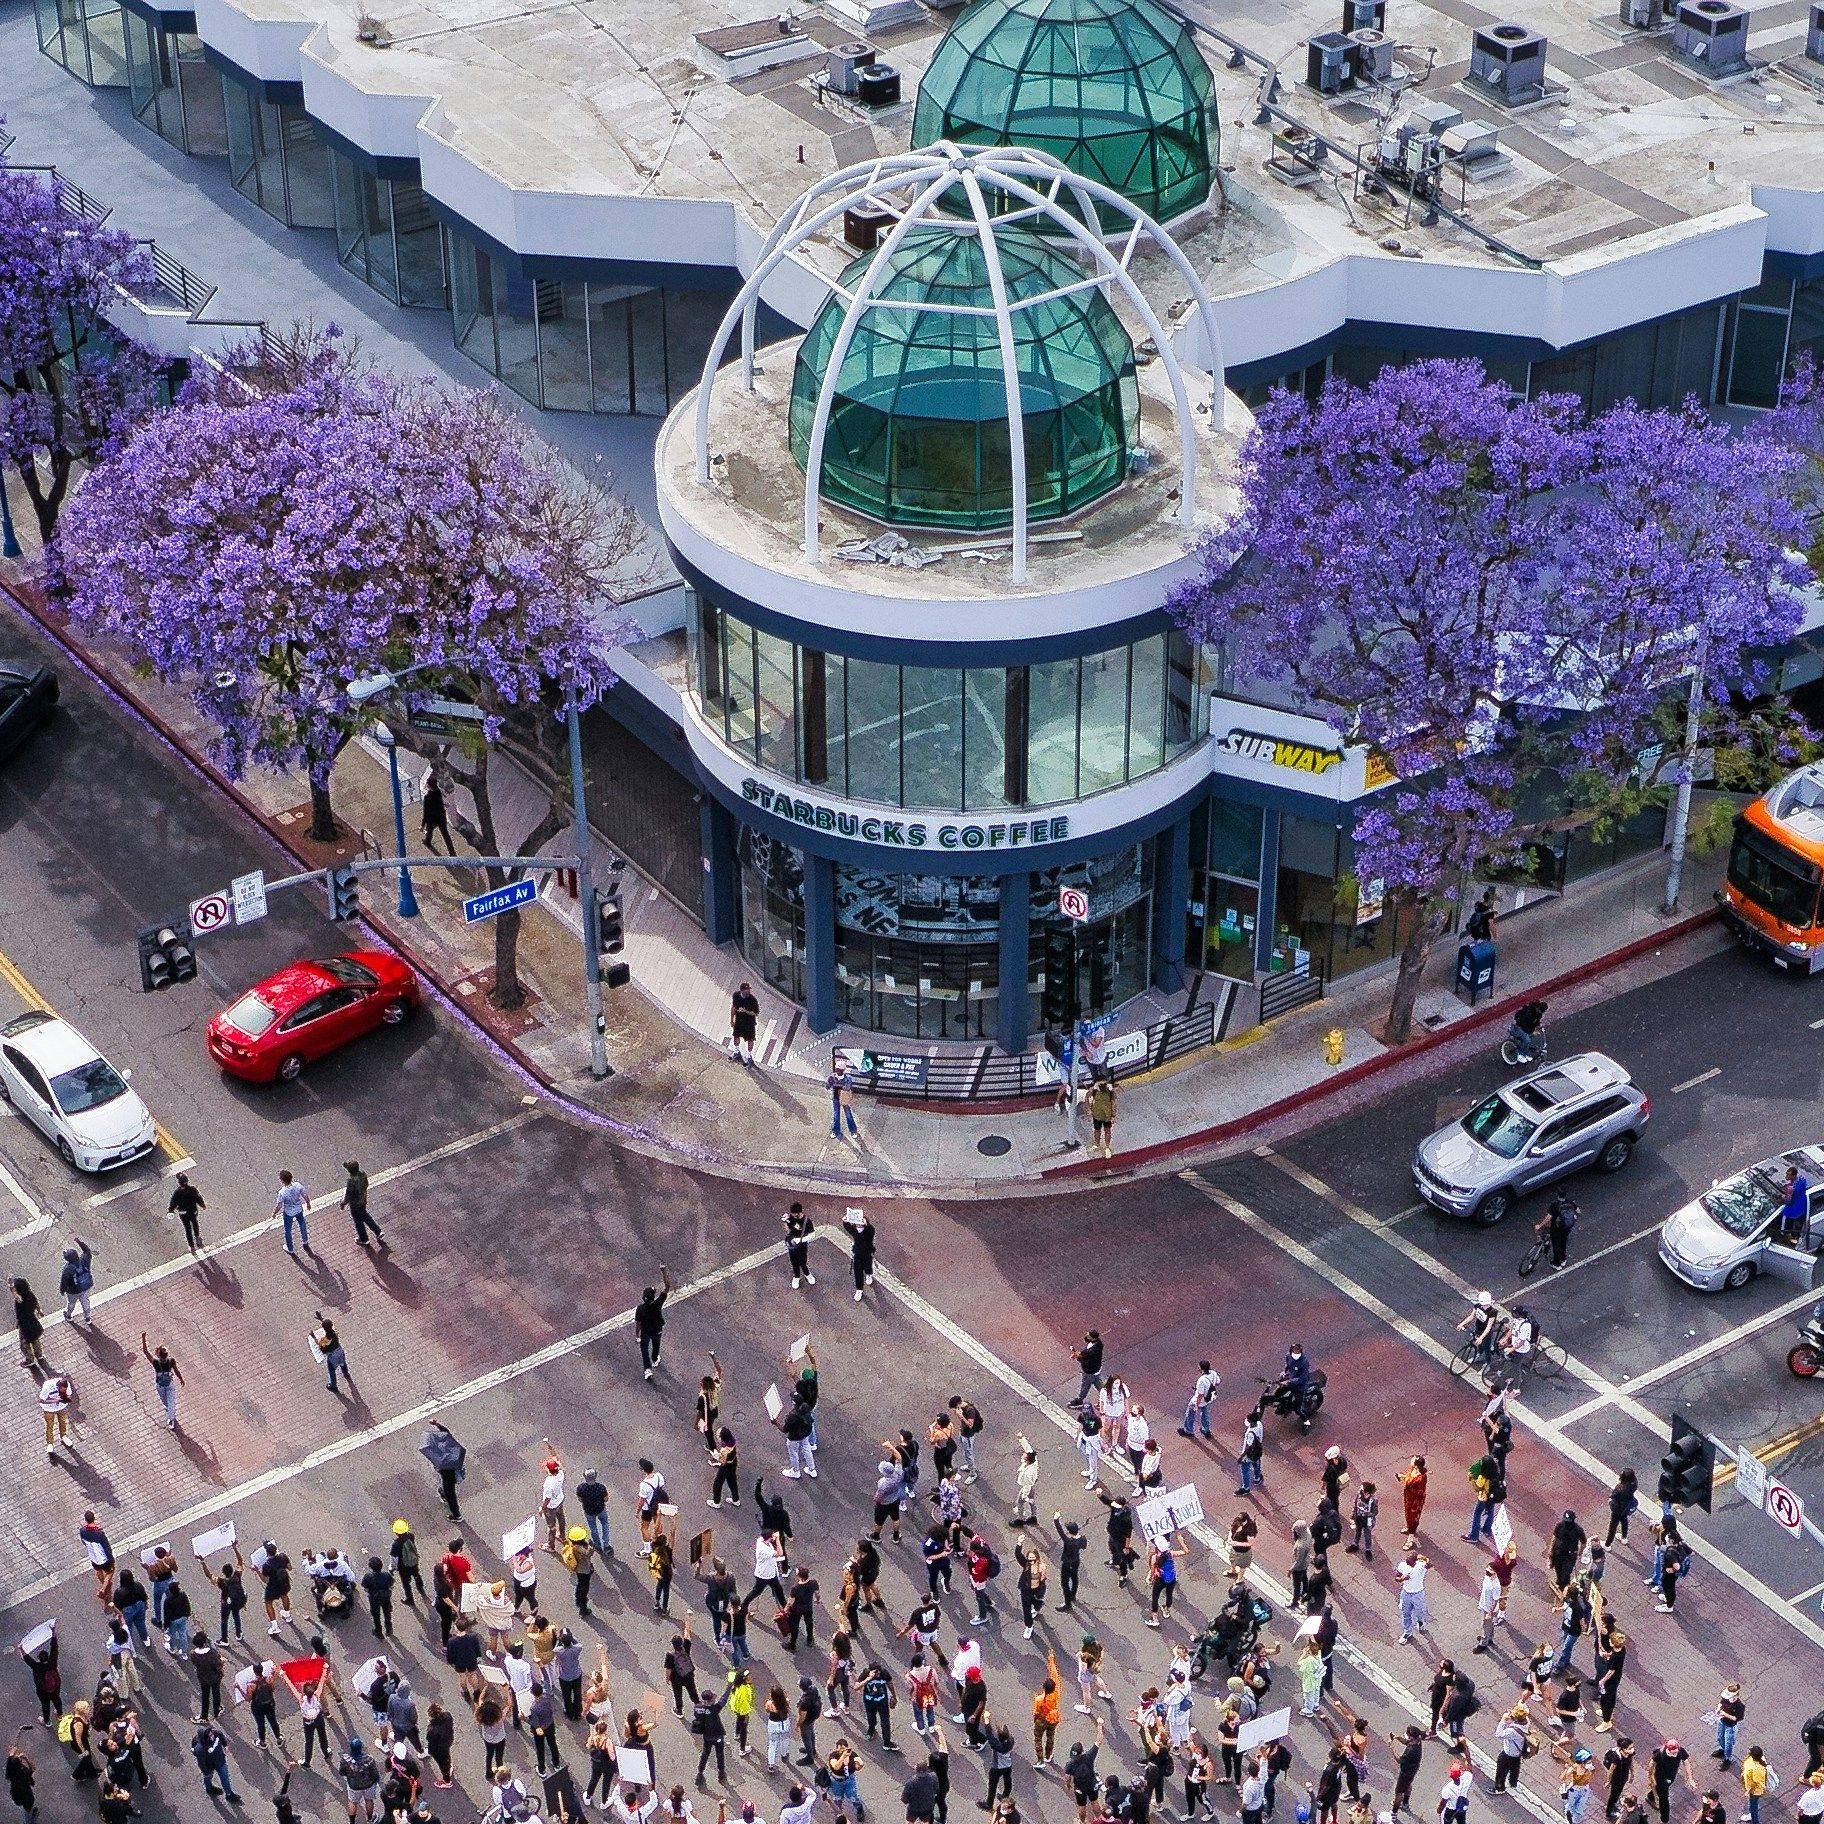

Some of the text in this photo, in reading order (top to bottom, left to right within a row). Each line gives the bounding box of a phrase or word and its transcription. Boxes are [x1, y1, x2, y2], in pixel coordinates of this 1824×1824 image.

[1221, 729, 1342, 775] SUBWAY
[1638, 743, 1663, 762] FREE
[741, 779, 1069, 850] STARBUCKS COFFEE
[472, 887, 527, 916] Fairfax Av
